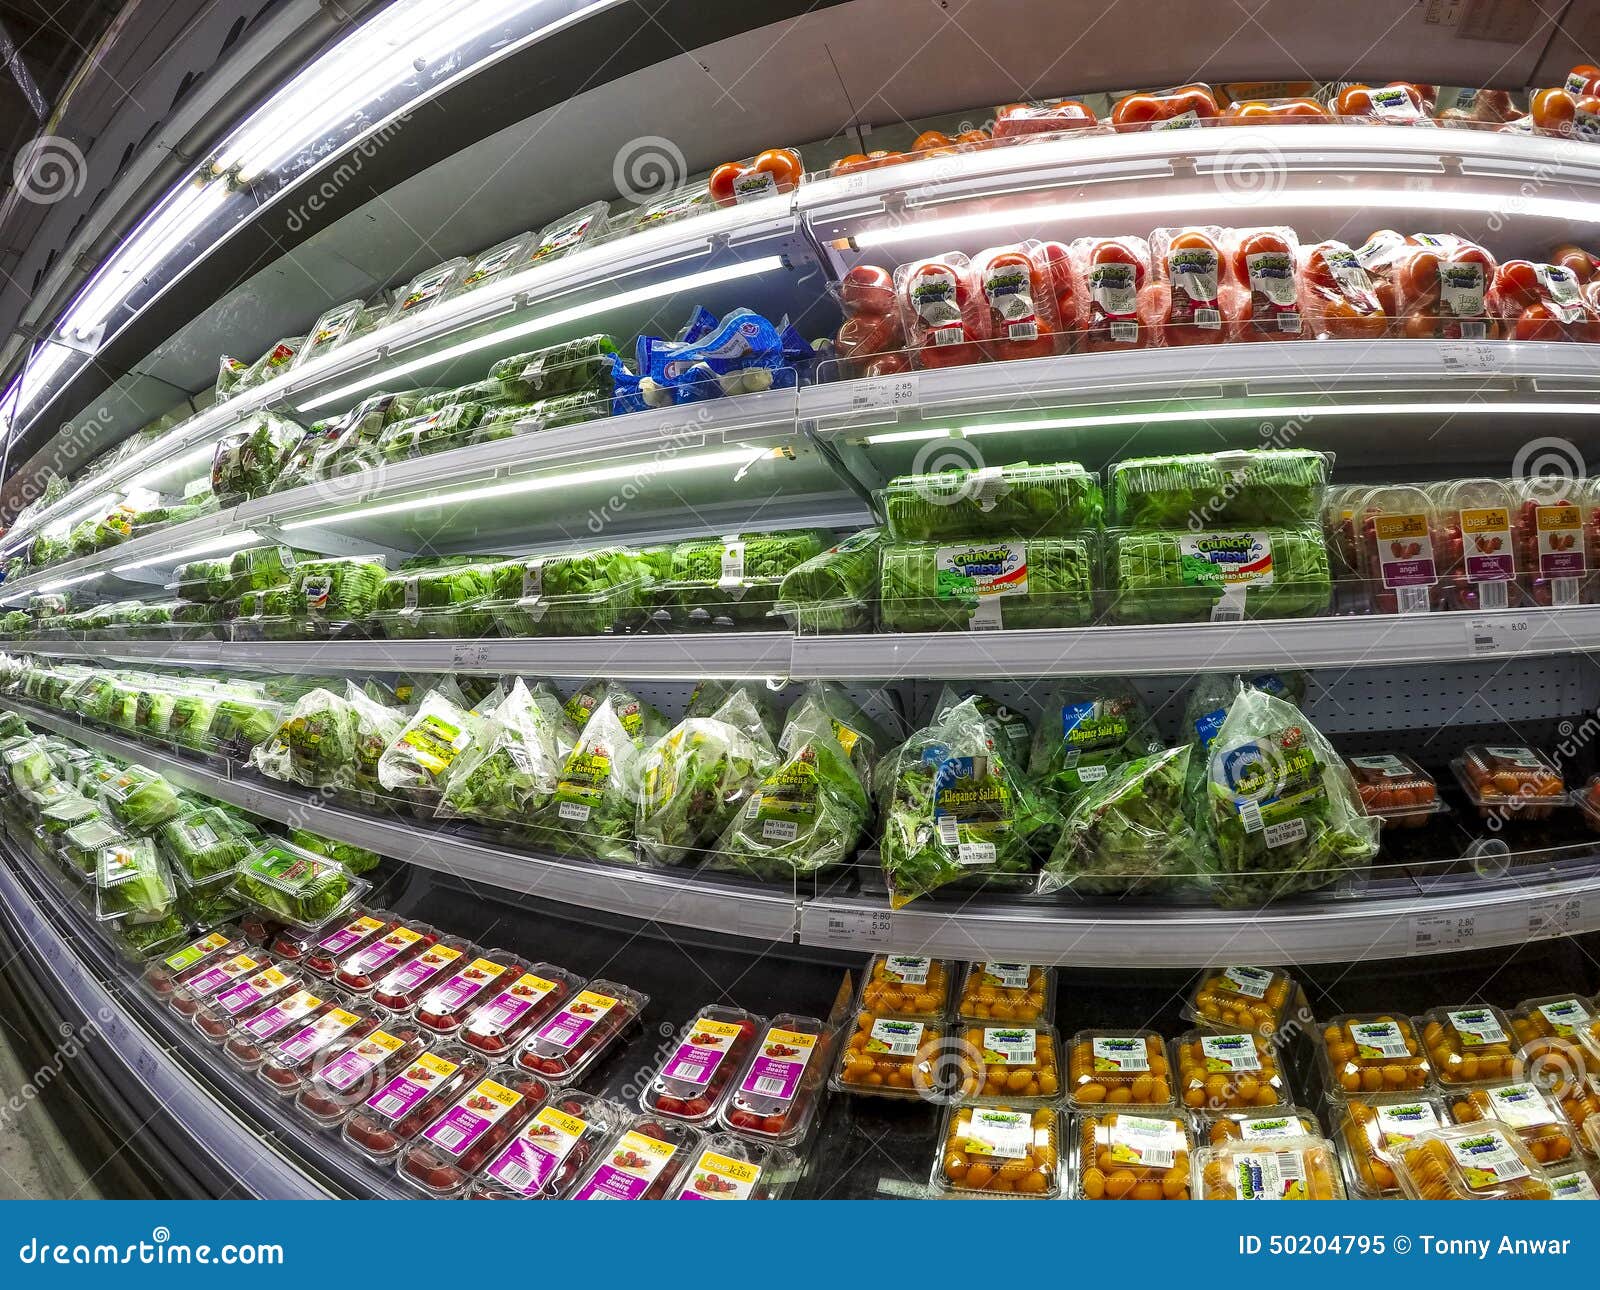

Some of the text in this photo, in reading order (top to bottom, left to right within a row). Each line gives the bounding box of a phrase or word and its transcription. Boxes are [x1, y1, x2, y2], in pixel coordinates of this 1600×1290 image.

[1466, 513, 1504, 527] beekist
[1198, 537, 1253, 553] CRUNCHY
[954, 550, 1010, 566] CRUNCHY
[1209, 551, 1247, 563] FRESH
[964, 564, 1002, 575] FRESH
[1511, 622, 1528, 631] 8.00
[576, 765, 600, 775] Greens
[1239, 756, 1308, 792] Elegance Salad Mix
[782, 774, 808, 784] Greens
[944, 788, 977, 805] Elegance
[979, 787, 997, 800] Salad
[872, 912, 891, 920] 2.80
[872, 922, 891, 930] 5.50
[768, 1062, 791, 1071] sweet
[460, 1112, 480, 1123] sweet
[982, 1113, 1021, 1122] CRUNCHY
[1459, 1136, 1496, 1150] CRUNCHY
[704, 1159, 752, 1180] beekist
[610, 1172, 635, 1184] sweet
